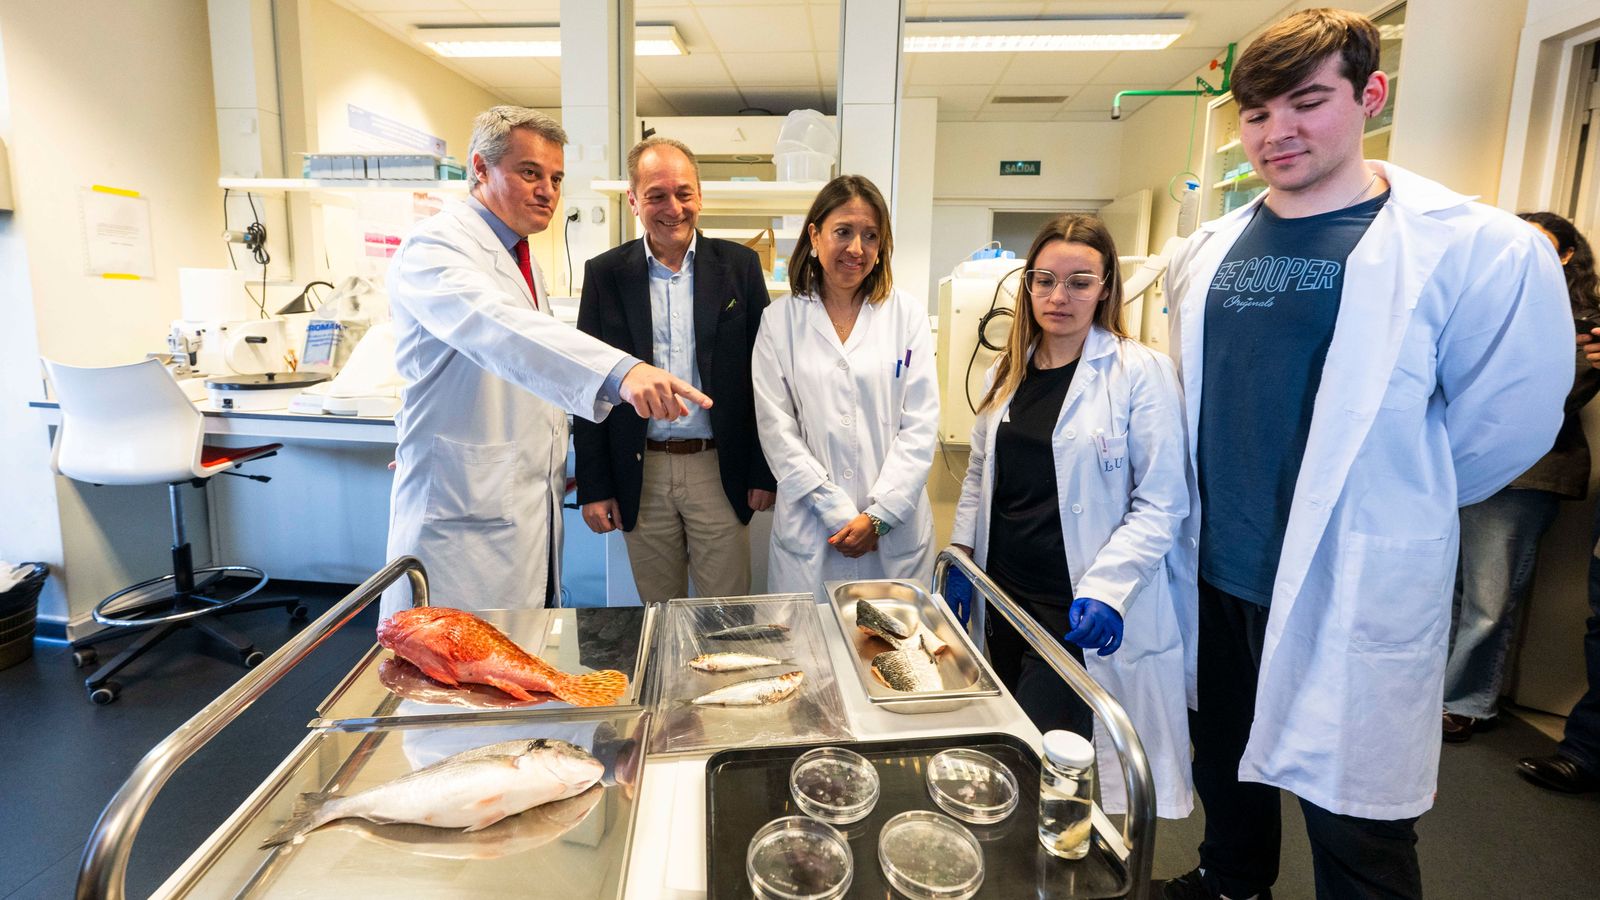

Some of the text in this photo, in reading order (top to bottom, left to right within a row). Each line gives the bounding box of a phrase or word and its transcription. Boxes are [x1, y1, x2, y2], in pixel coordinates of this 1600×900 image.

[1004, 163, 1036, 173] SALIDA
[1210, 256, 1342, 293] EE COOPER
[1223, 294, 1276, 313] Originals
